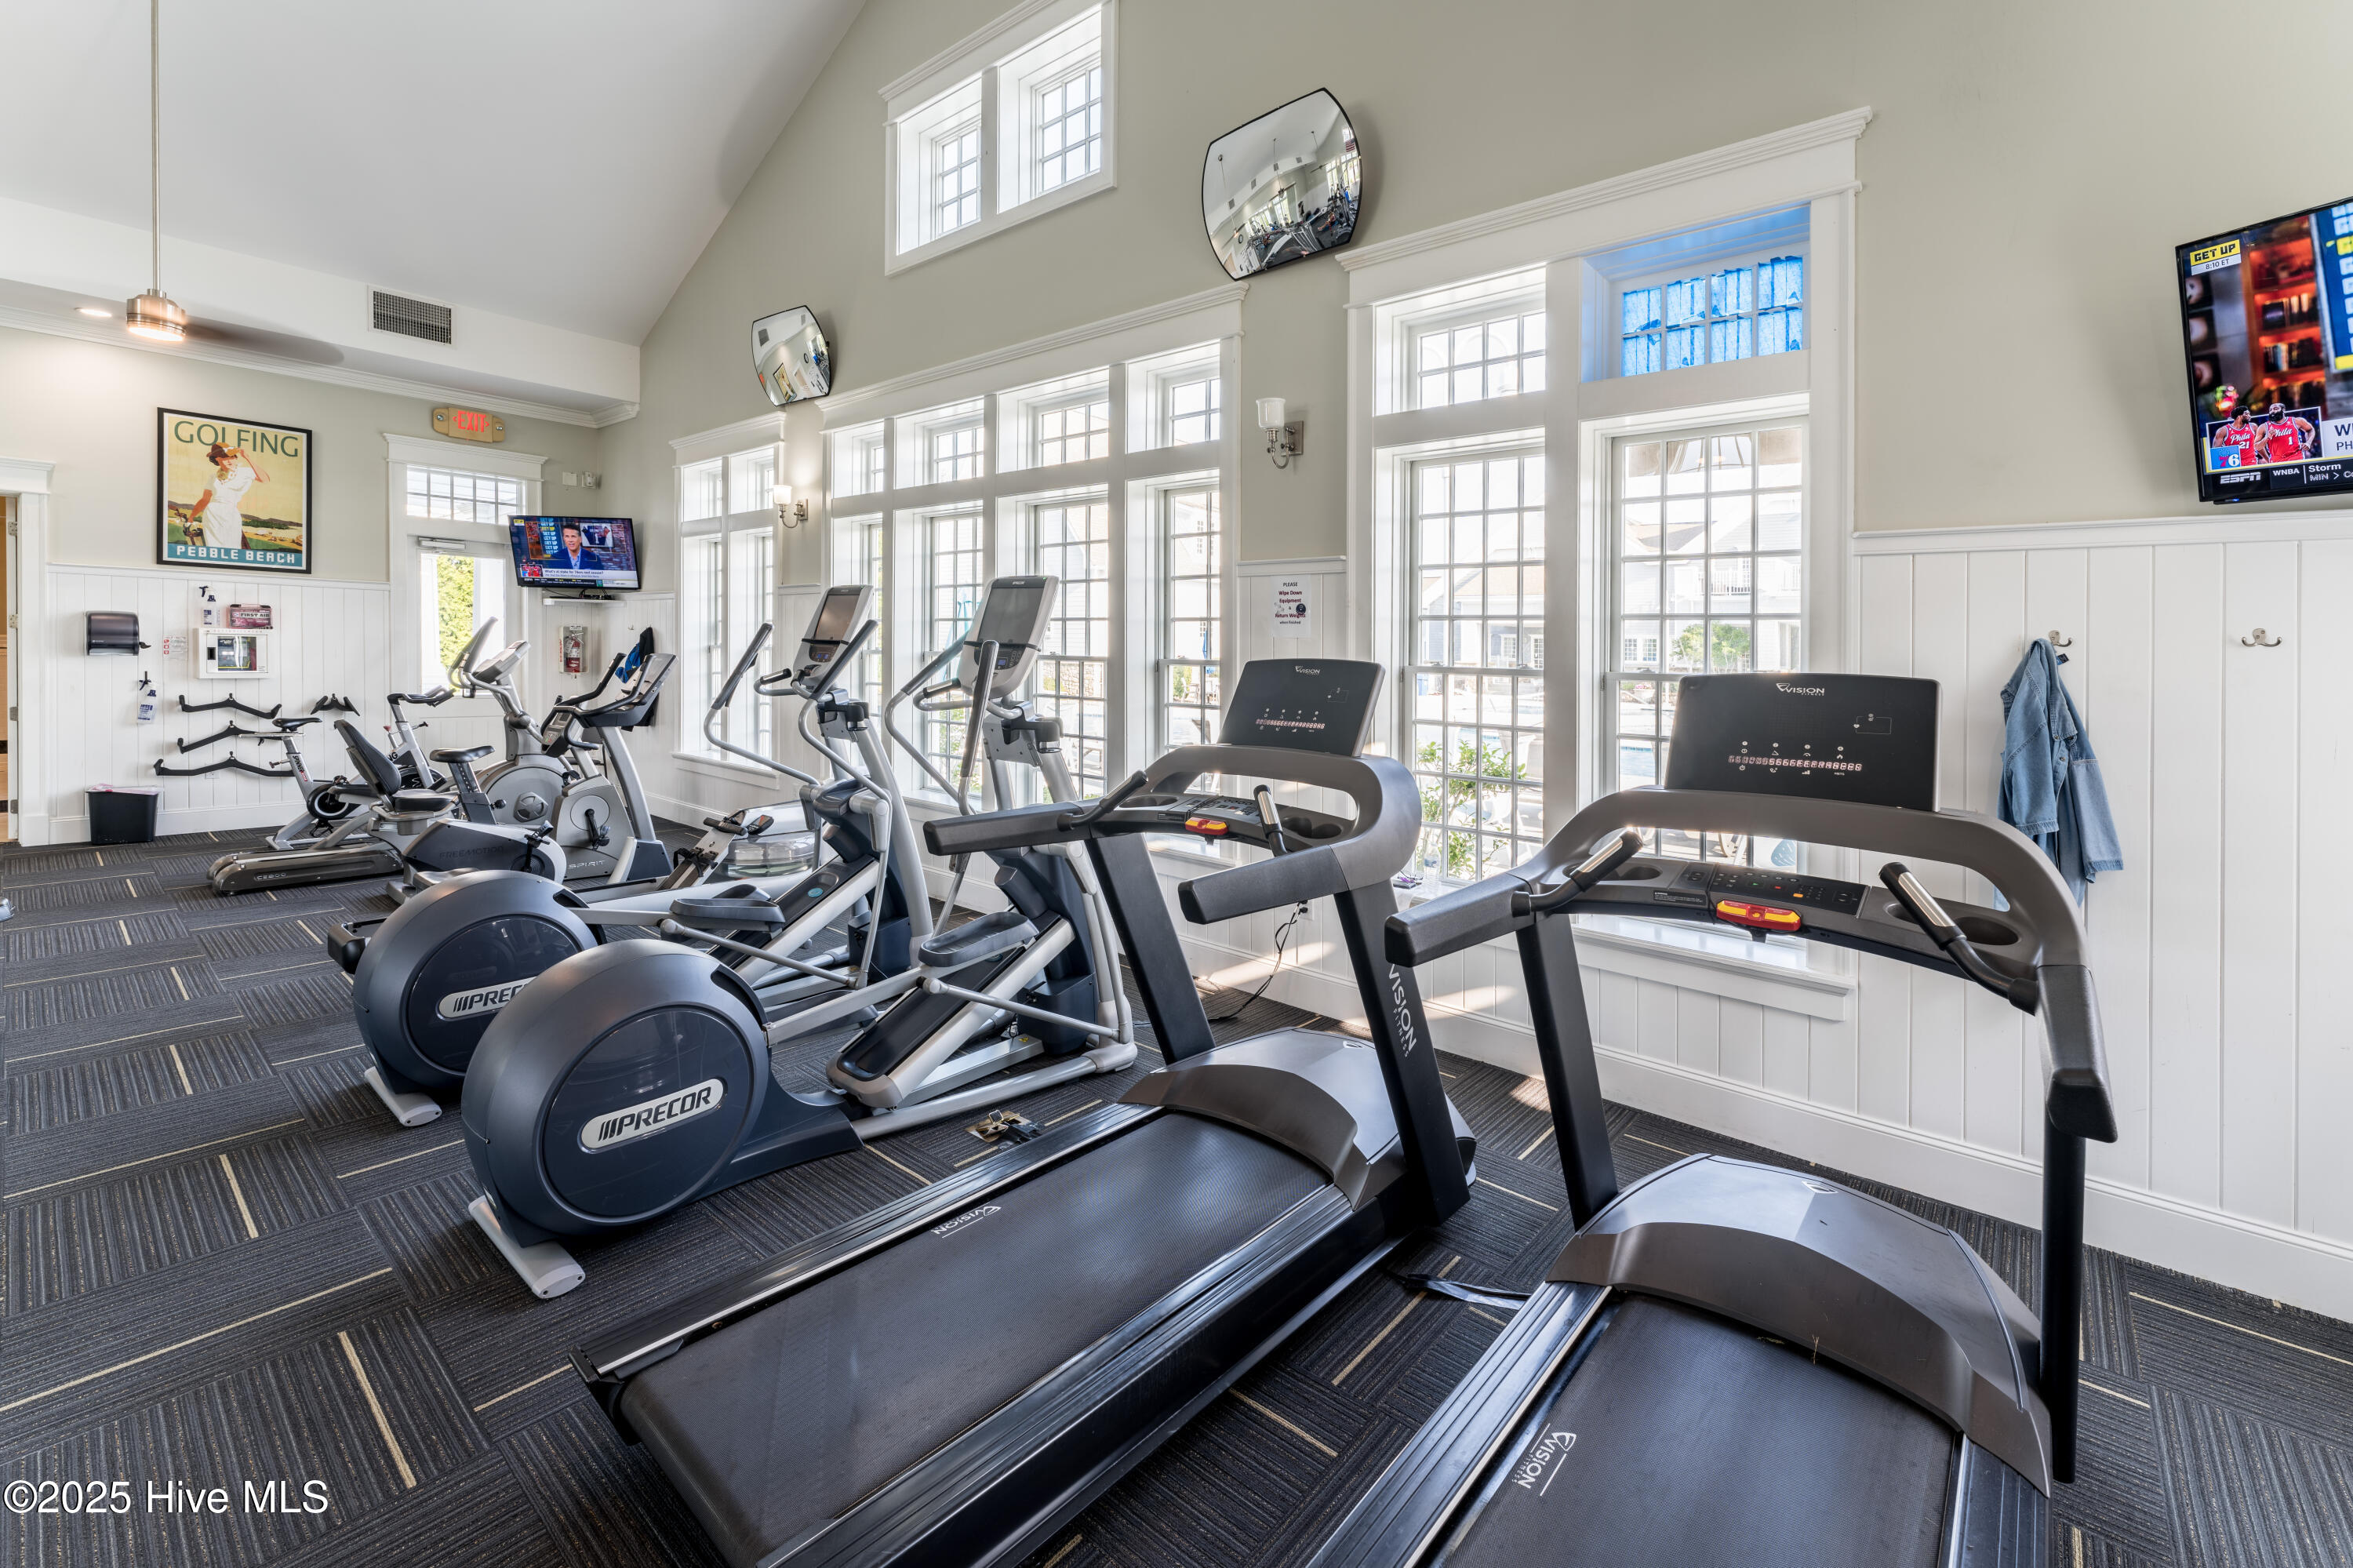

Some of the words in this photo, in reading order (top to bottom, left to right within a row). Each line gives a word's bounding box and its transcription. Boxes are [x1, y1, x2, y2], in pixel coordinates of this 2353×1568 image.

[2194, 249, 2217, 262] GET
[2220, 243, 2235, 255] UP
[2206, 261, 2220, 270] 8:10
[457, 409, 487, 433] EXIT
[2230, 434, 2250, 444] Phila
[2219, 453, 2239, 467] 76
[2308, 464, 2341, 472] Storm
[2220, 471, 2261, 484] ESPN
[2273, 467, 2300, 477] WNBA
[2309, 473, 2329, 482] MIN
[176, 545, 238, 560] PEBBLE
[245, 551, 295, 564] BEACH
[293, 755, 305, 772] SPINNER
[569, 860, 606, 869] SPIRIT
[467, 984, 528, 1010] PREC
[1388, 963, 1417, 1052] VISION
[1393, 1009, 1409, 1058] FITNESS
[616, 1086, 711, 1137] PRECOR
[933, 1209, 984, 1235] VISION
[1517, 1439, 1558, 1489] VISION
